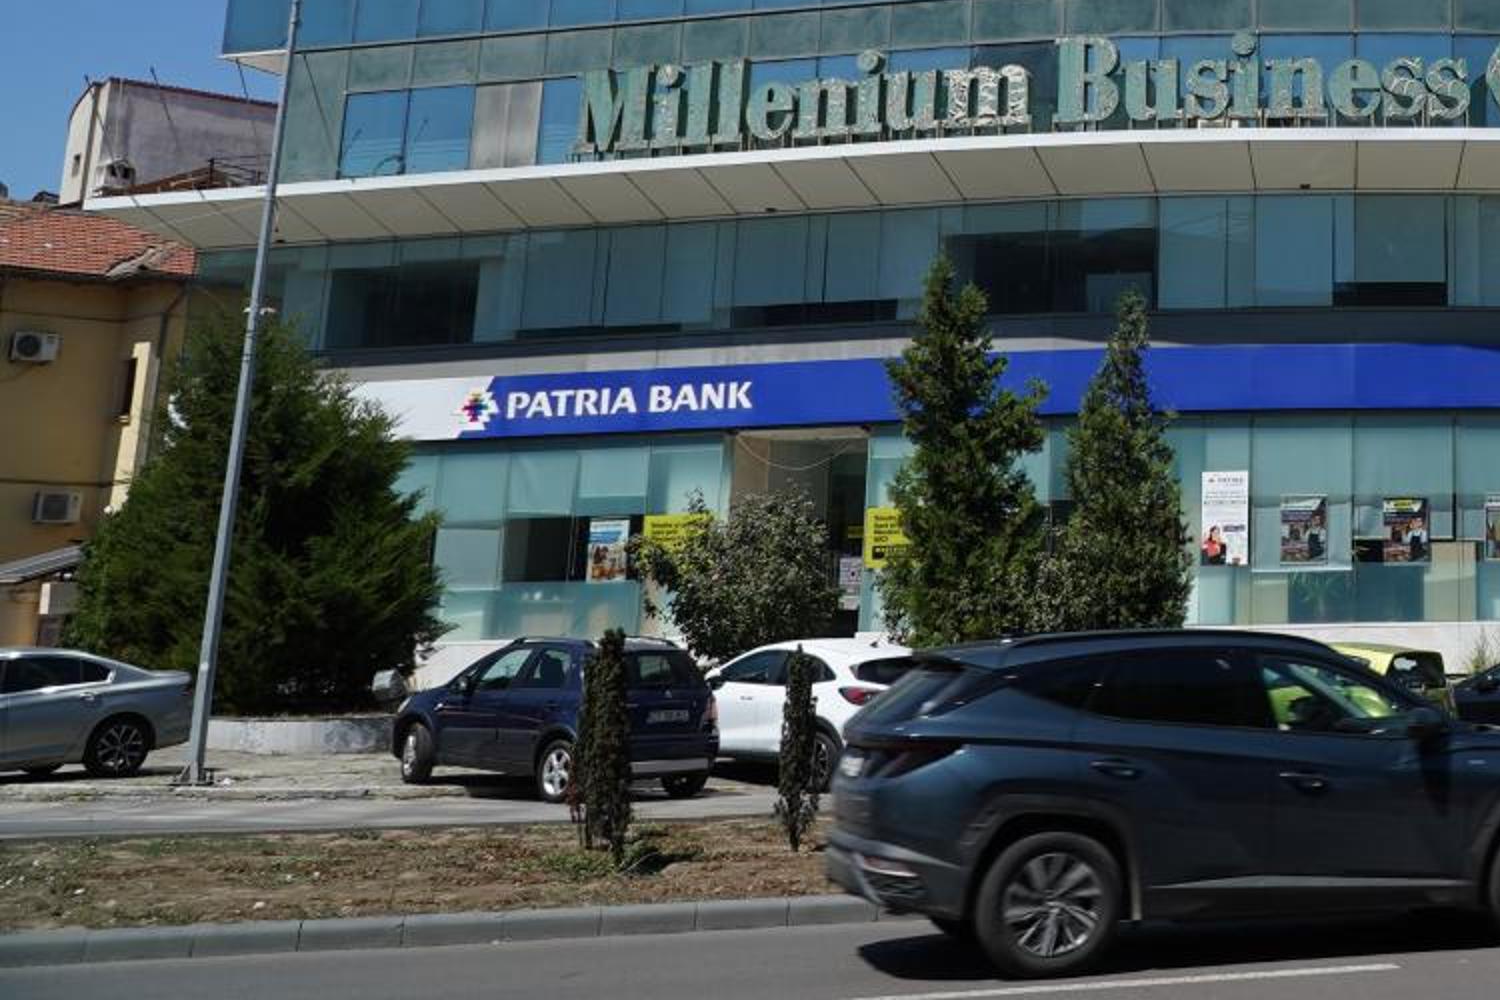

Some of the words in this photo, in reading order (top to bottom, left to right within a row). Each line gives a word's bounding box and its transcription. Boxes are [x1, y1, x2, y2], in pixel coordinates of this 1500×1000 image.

[574, 48, 1033, 154] Millenium
[1052, 30, 1471, 123] Business
[506, 388, 637, 420] PATRIA
[649, 381, 753, 413] BANK
